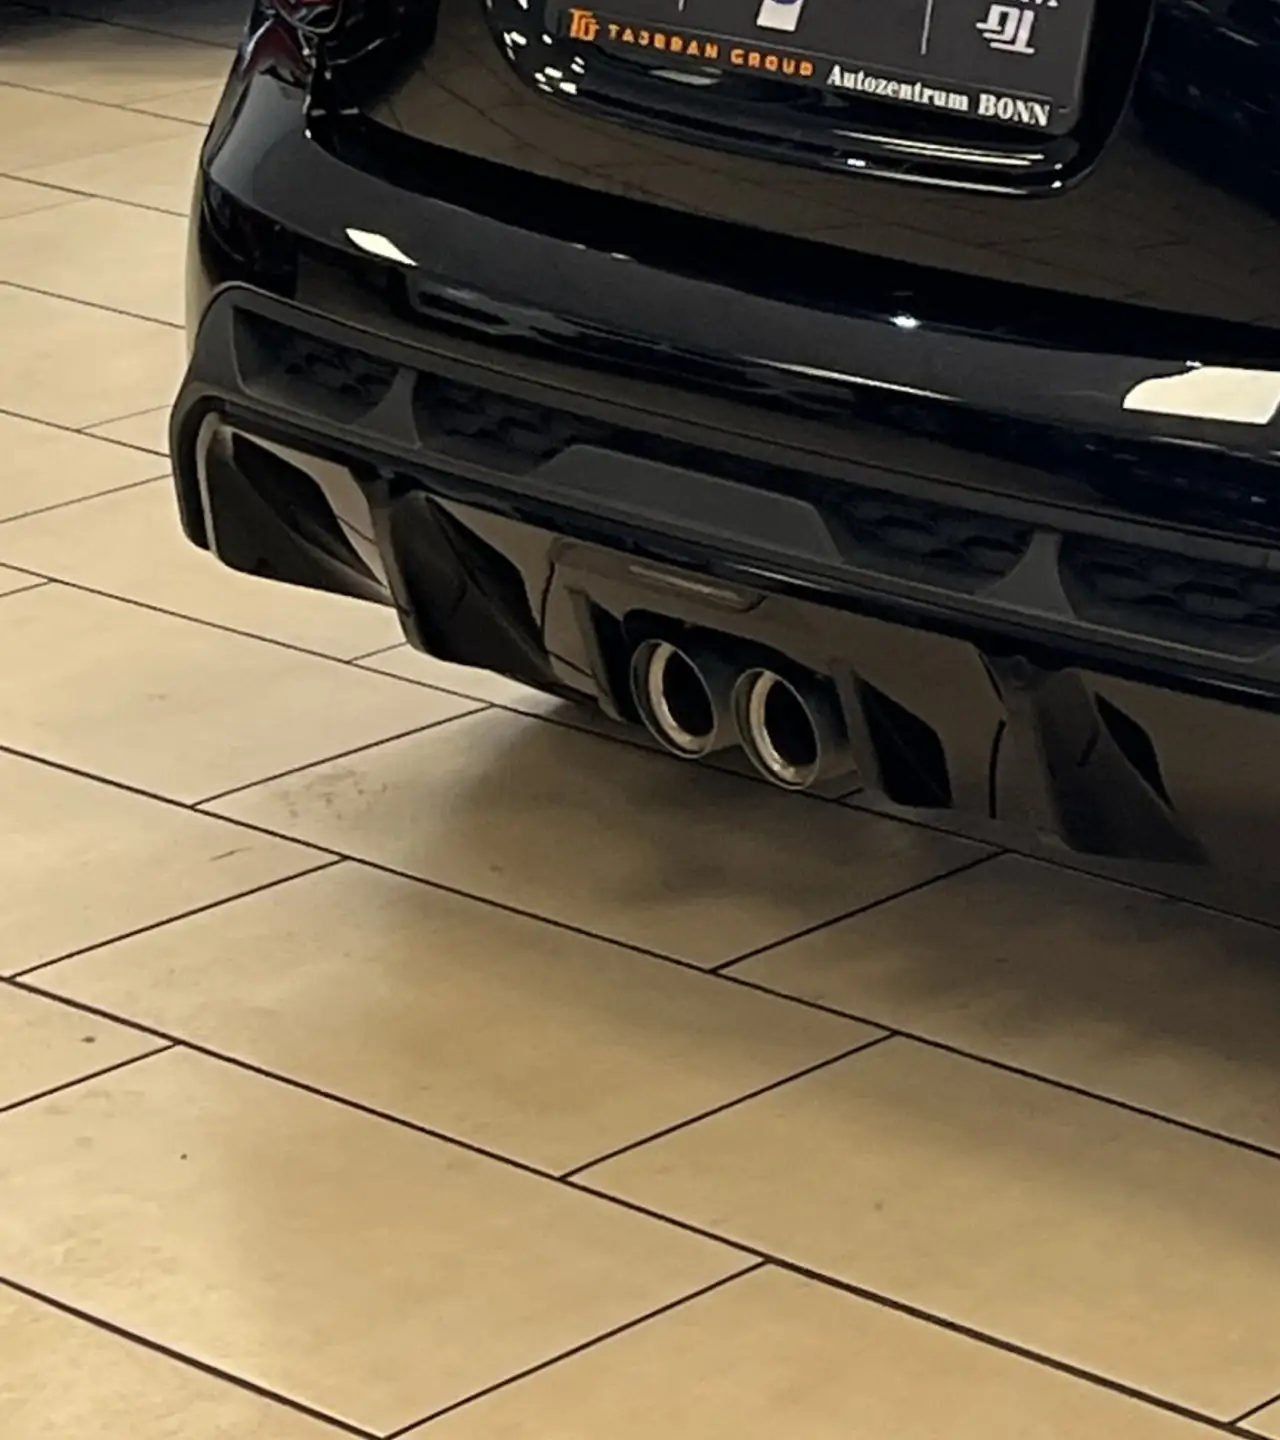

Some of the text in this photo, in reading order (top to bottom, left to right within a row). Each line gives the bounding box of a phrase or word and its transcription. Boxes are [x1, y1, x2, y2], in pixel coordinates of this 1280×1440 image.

[729, 48, 814, 77] GROUP
[826, 64, 1050, 127] Autozentrum BONN
